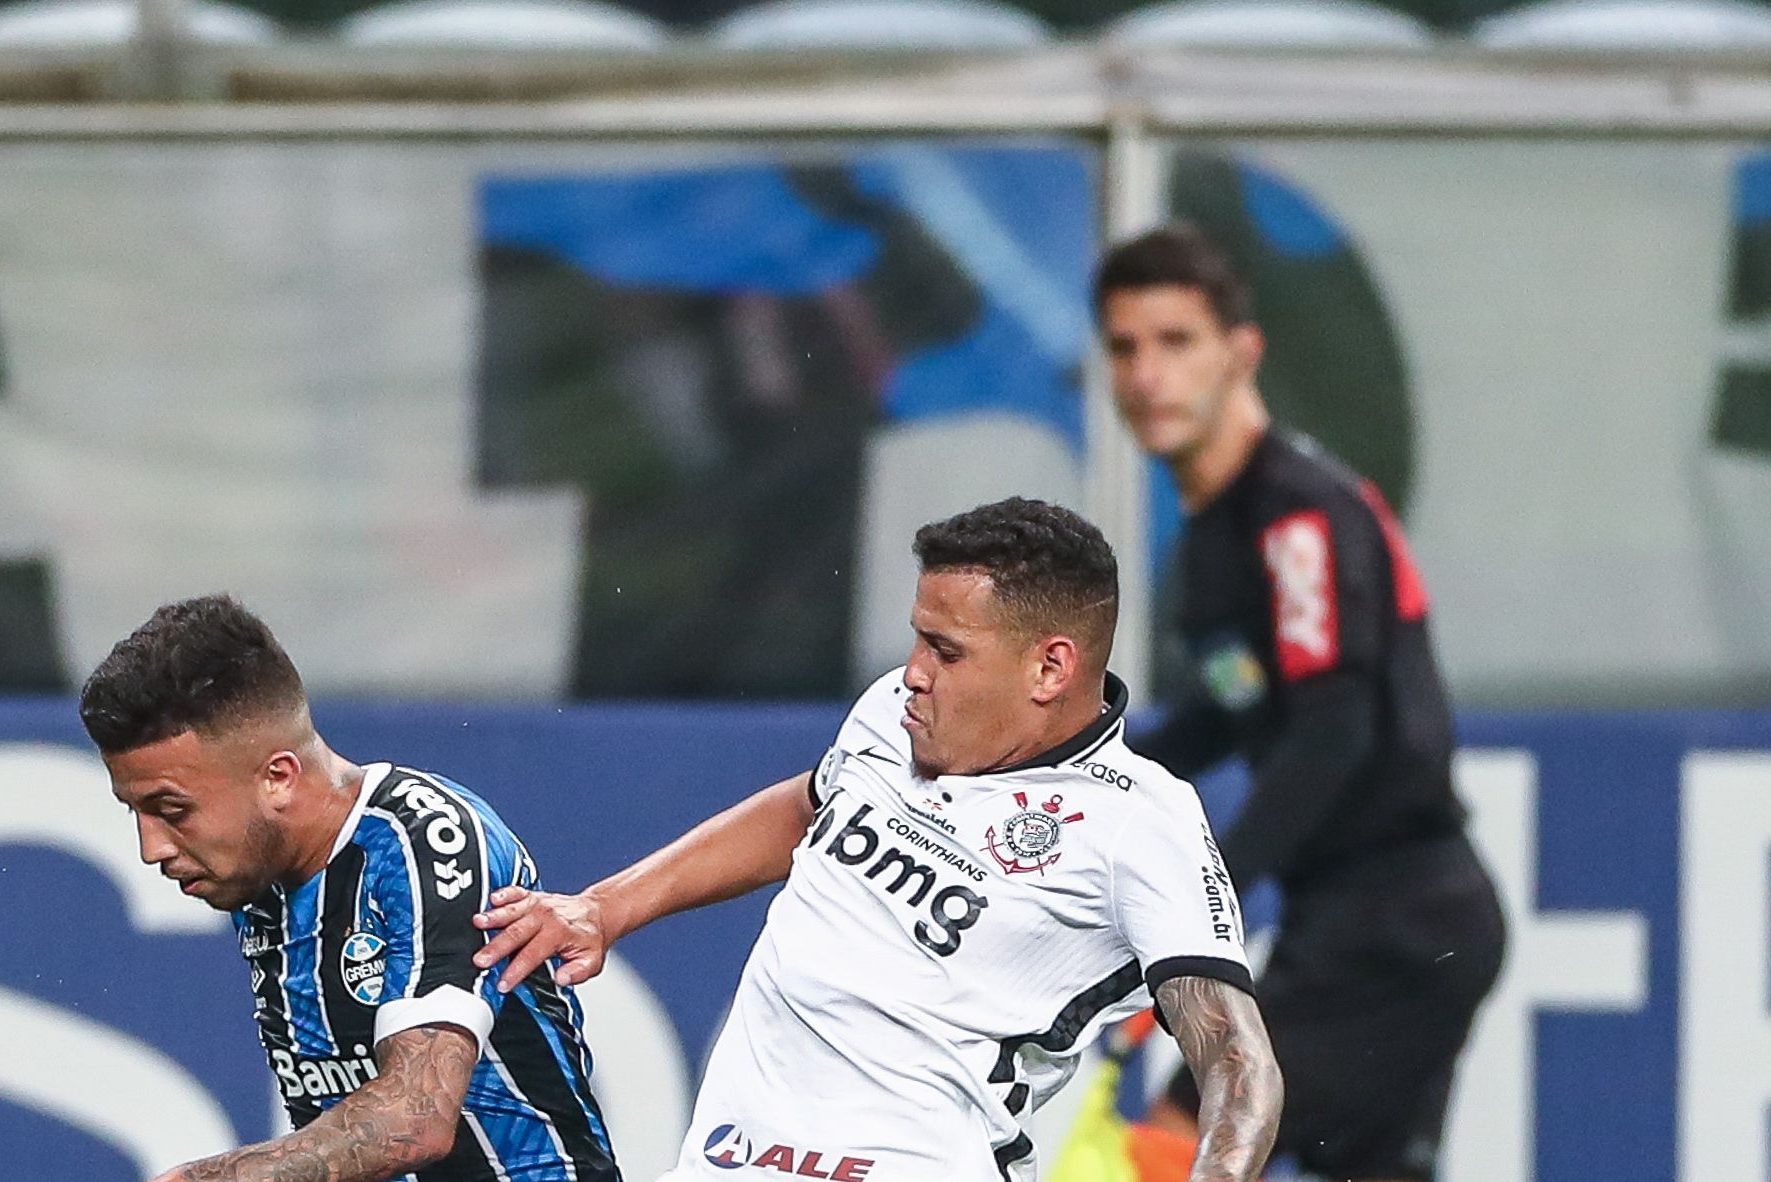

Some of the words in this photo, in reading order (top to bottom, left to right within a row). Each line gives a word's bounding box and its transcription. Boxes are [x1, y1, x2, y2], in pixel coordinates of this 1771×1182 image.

[824, 803, 989, 957] bmg
[886, 817, 988, 882] CORINTHIANS
[1201, 866, 1232, 942] .com.br
